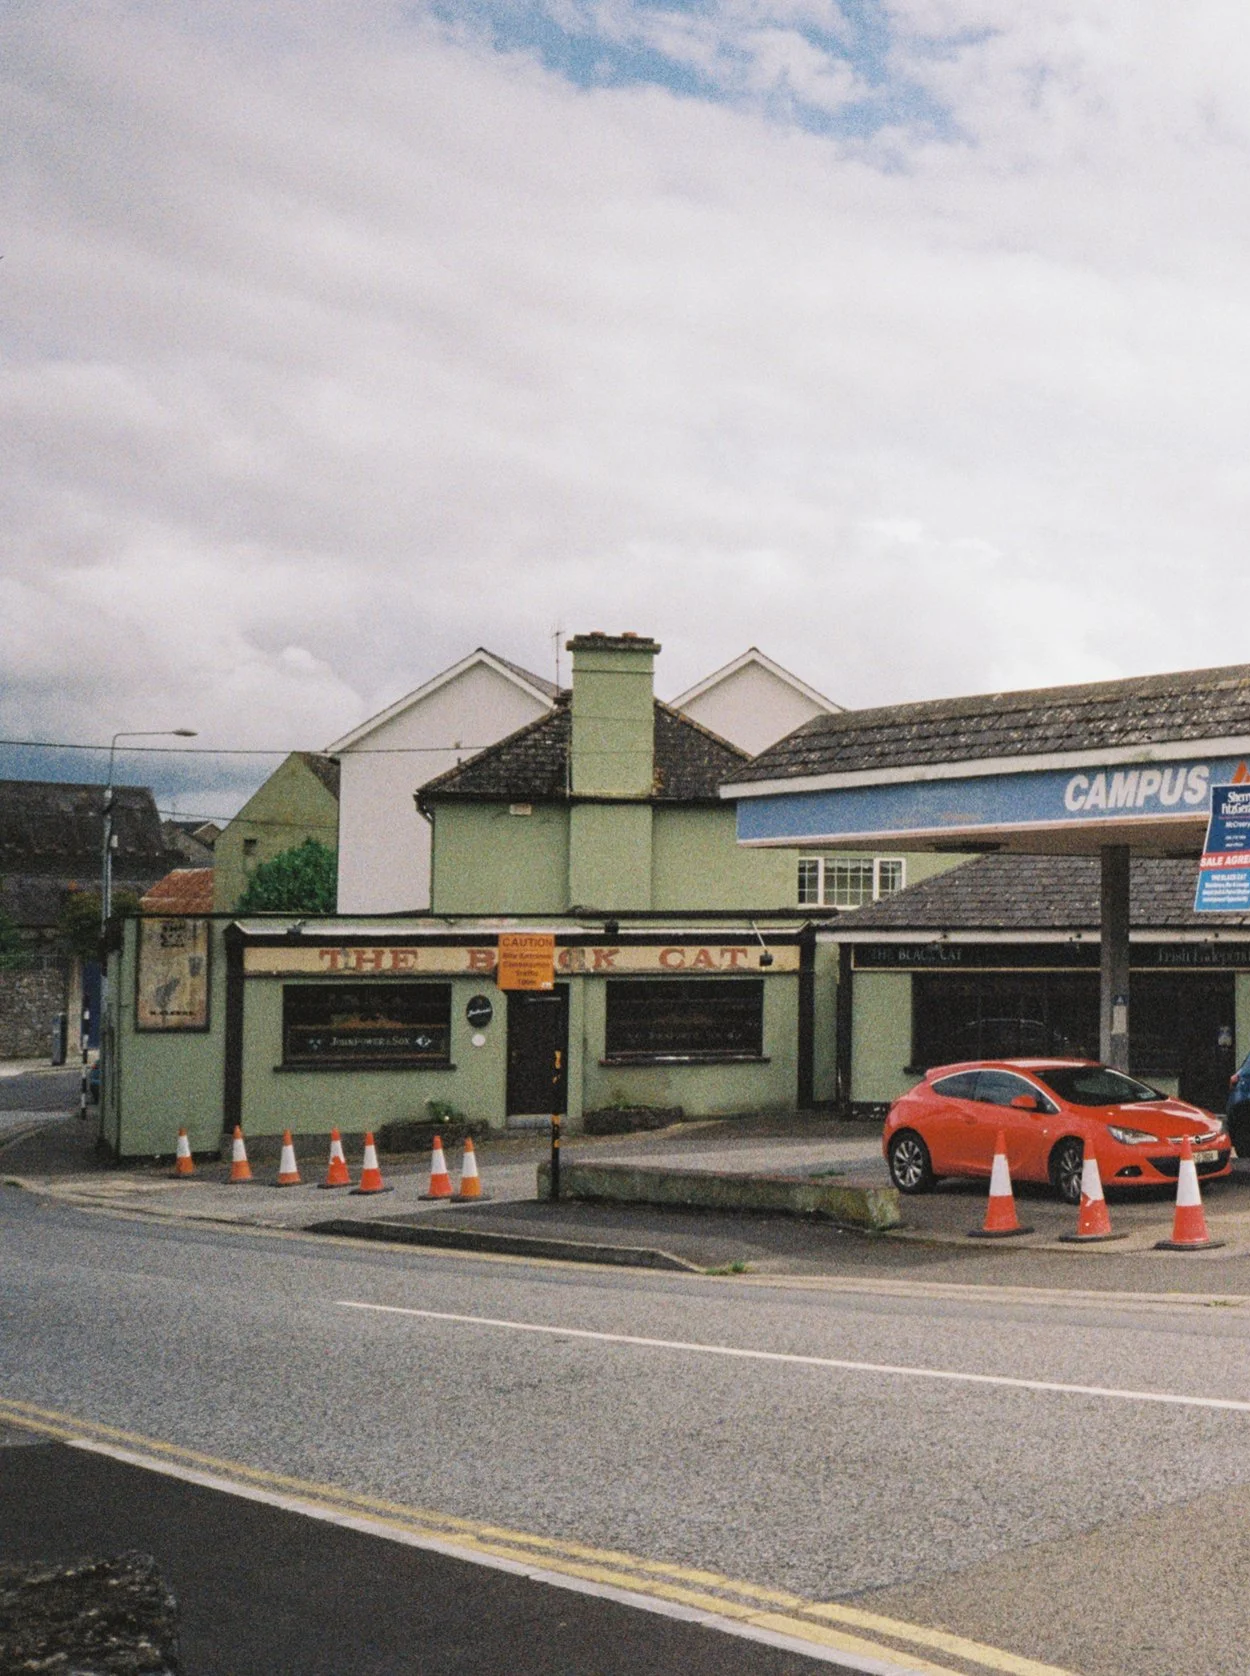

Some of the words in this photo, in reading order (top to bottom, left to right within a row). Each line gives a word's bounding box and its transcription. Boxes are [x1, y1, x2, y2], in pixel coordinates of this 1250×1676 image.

[1064, 764, 1210, 811] CAMPUS
[1200, 856, 1224, 867] SALE
[502, 937, 554, 948] CAUTION
[319, 949, 418, 970] THE
[466, 948, 620, 970] BCK
[658, 947, 748, 969] CAT
